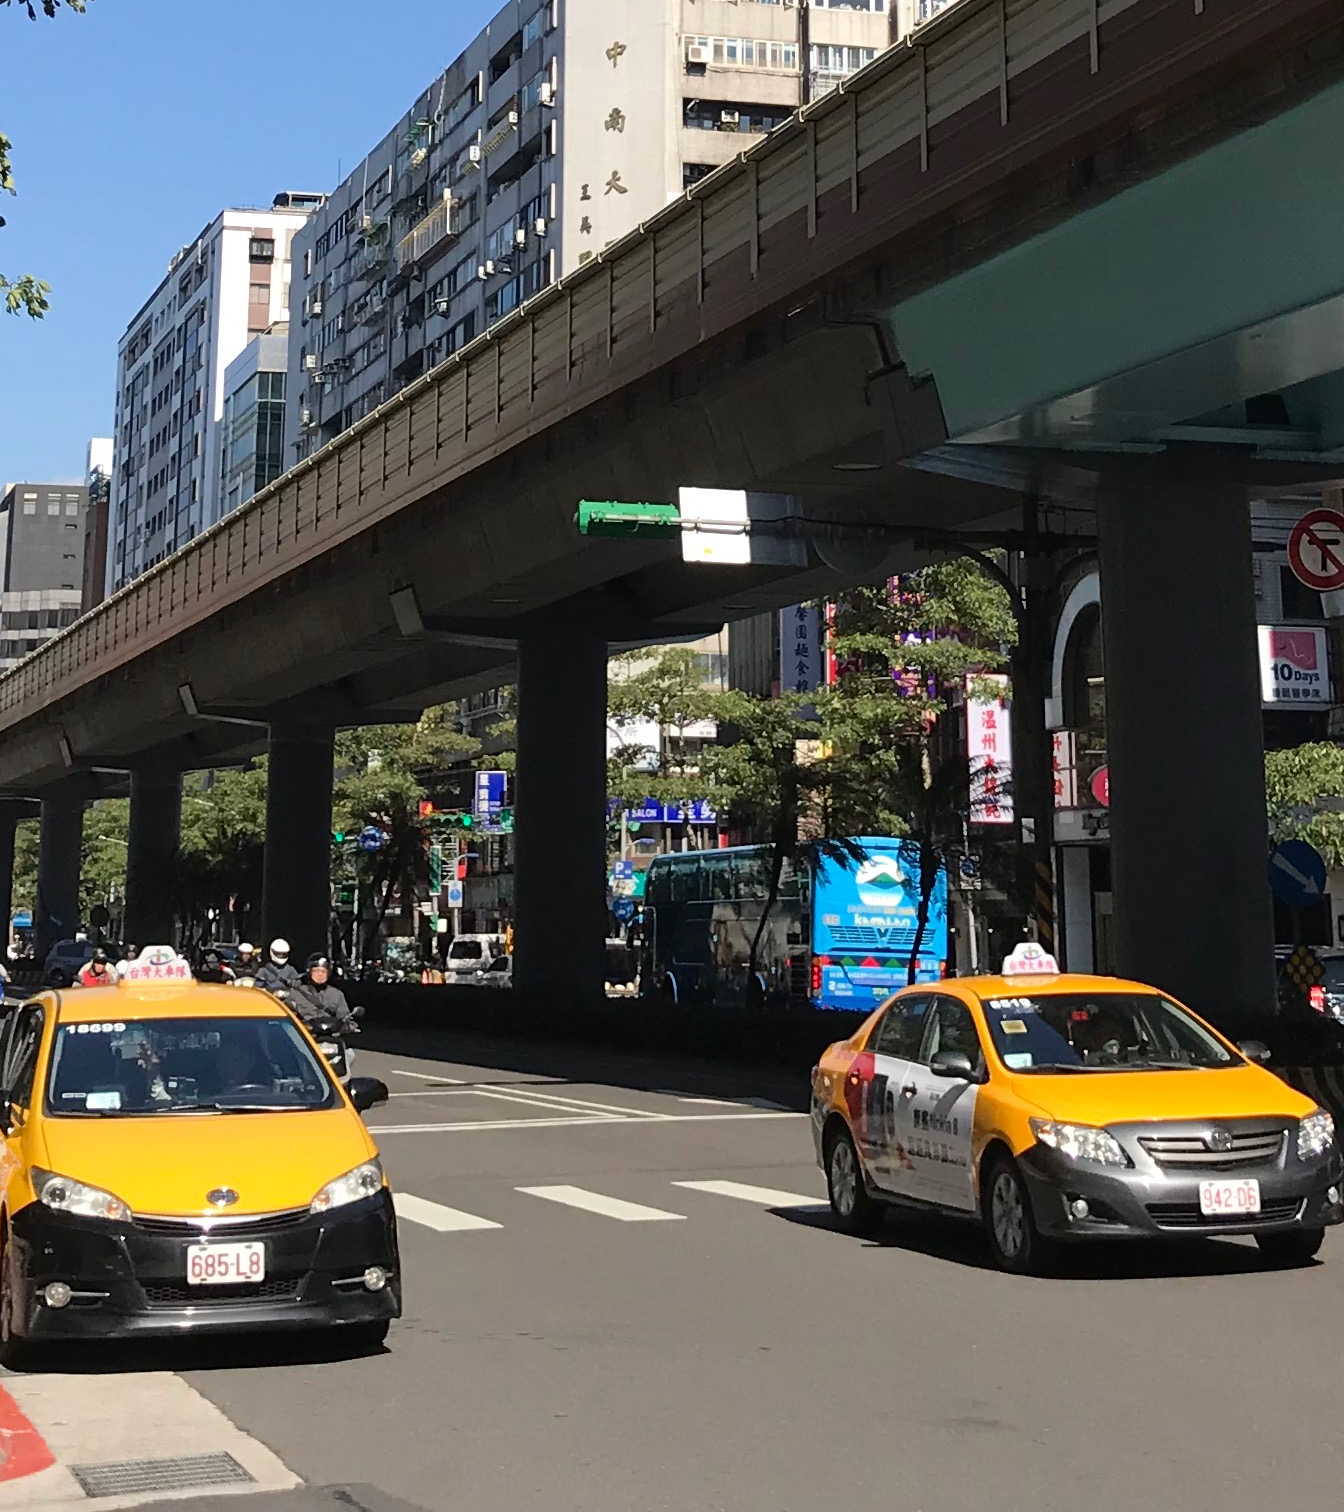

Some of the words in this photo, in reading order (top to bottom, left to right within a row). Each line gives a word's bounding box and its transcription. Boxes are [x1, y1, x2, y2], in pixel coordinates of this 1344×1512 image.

[604, 41, 629, 247] 中南大
[129, 964, 188, 980] 台灣大車隊
[1202, 1188, 1257, 1210] 942-D6
[190, 1246, 262, 1279] 685-L8
